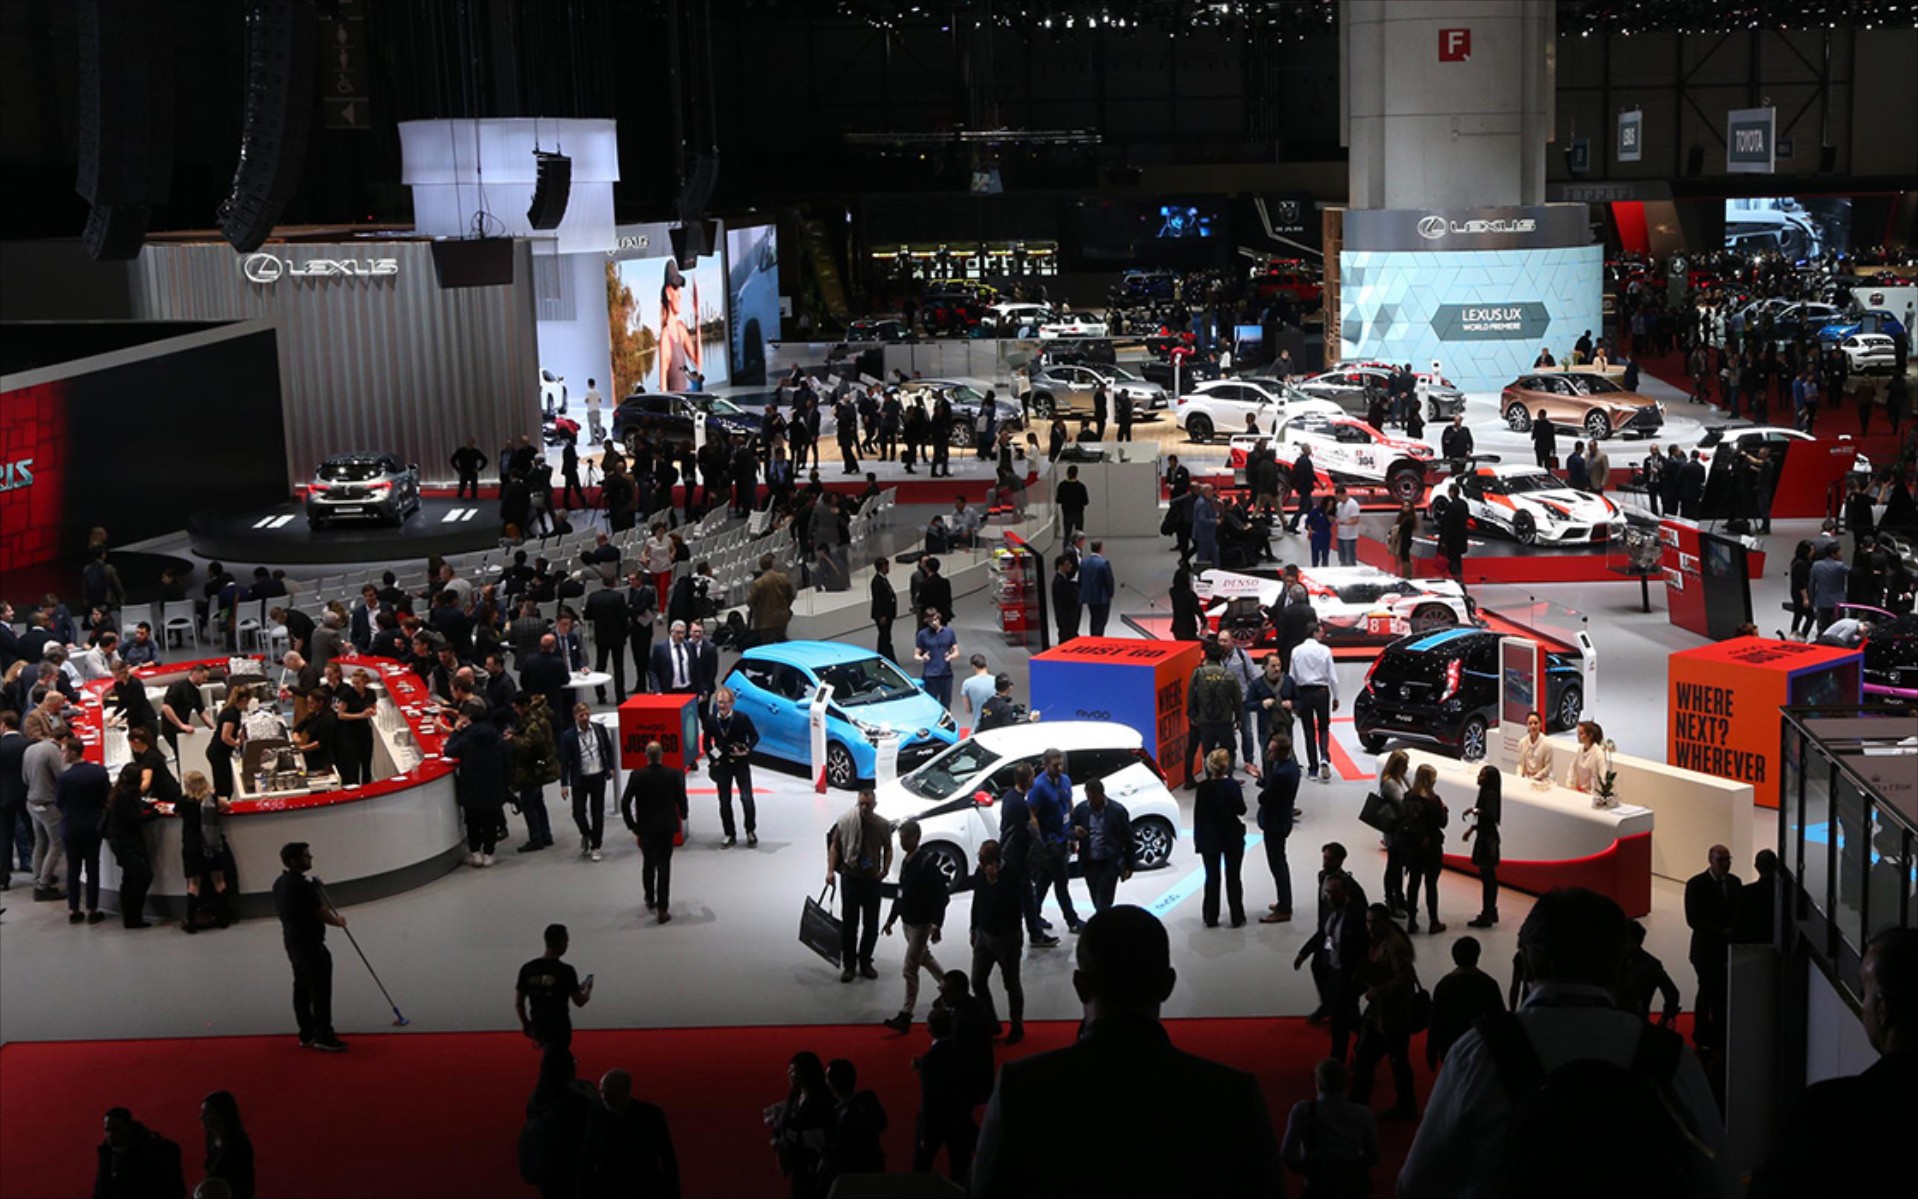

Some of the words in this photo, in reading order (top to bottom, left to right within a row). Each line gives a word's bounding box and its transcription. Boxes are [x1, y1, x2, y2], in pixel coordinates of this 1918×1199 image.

[1448, 31, 1464, 54] F
[1735, 129, 1764, 152] TOYOTA
[1450, 219, 1537, 233] LEXUS
[285, 258, 398, 276] LEXUS
[1462, 308, 1502, 322] LEXUS
[1503, 308, 1522, 321] UX
[1462, 323, 1489, 332] WORLD
[1489, 322, 1521, 332] PREMIERE
[1222, 579, 1259, 588] DENSO
[1369, 618, 1380, 633] 8
[1060, 645, 1125, 656] JUST
[1127, 649, 1167, 658] GO
[1675, 681, 1734, 718] WHERE
[1675, 711, 1729, 746] NEXT?
[660, 733, 679, 753] GO
[1675, 740, 1766, 783] WHEREVER
